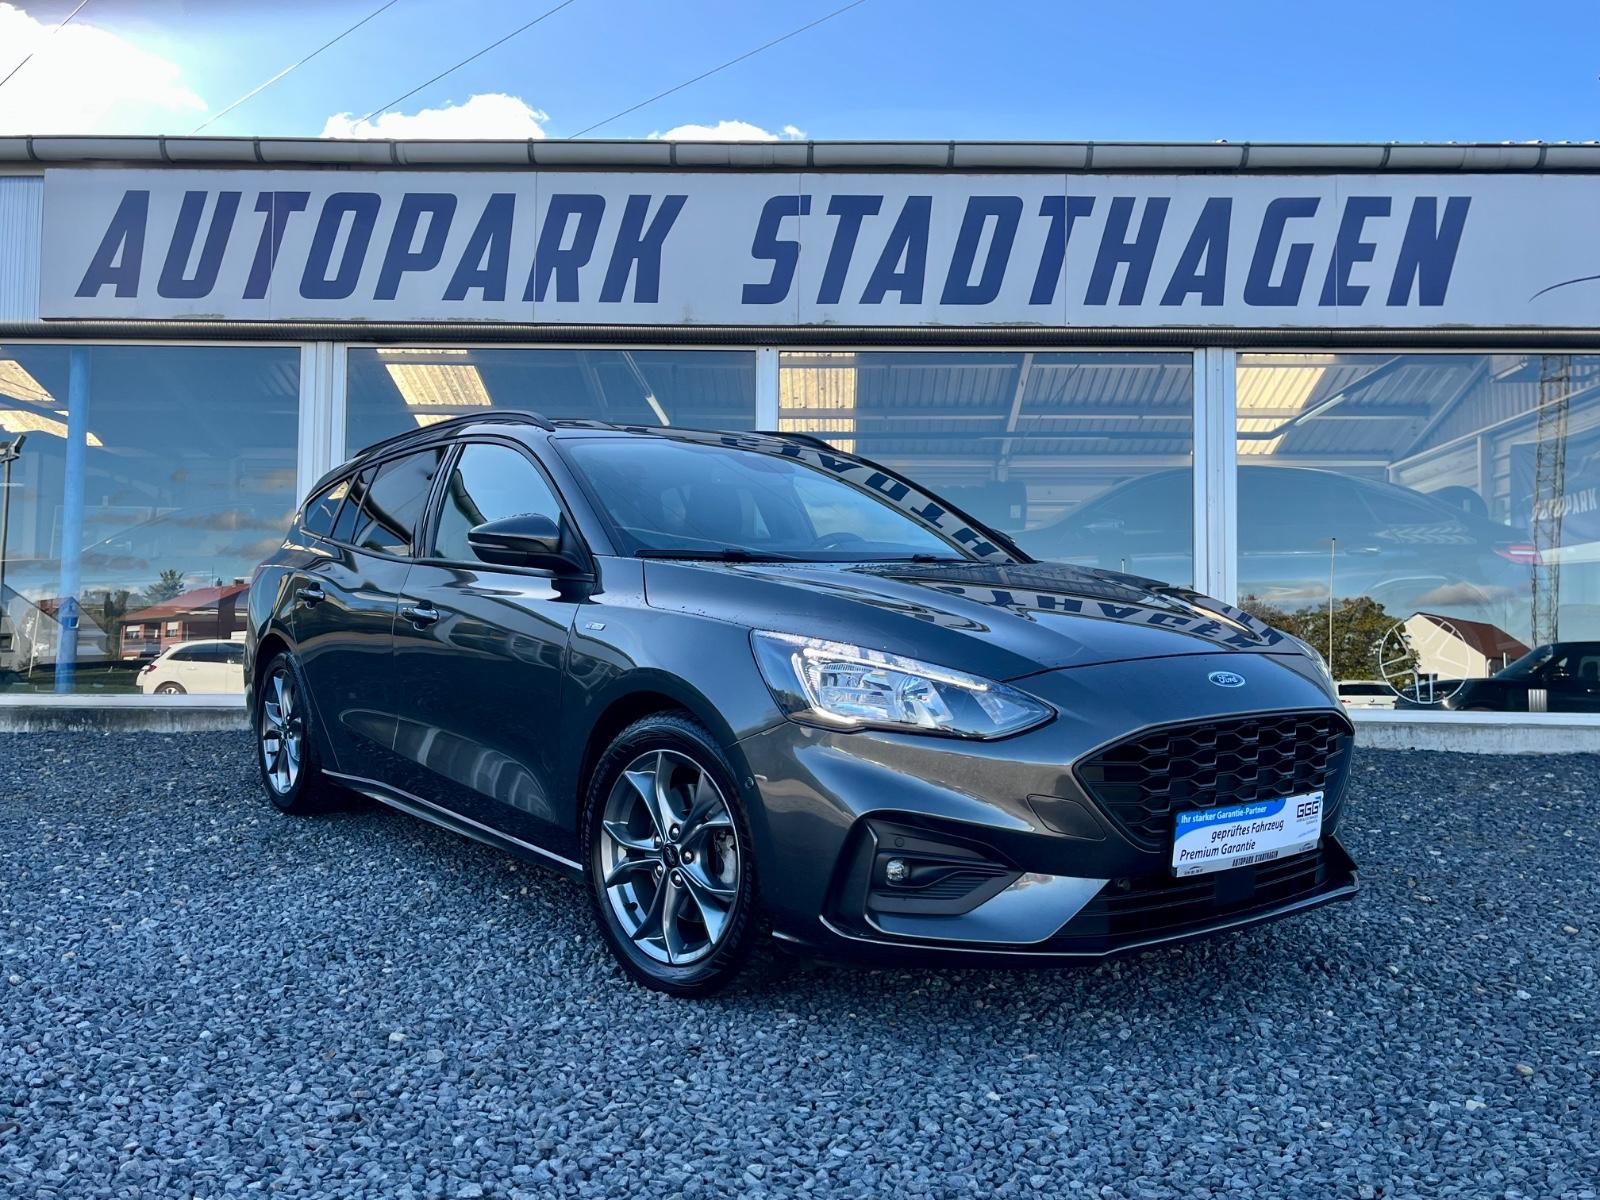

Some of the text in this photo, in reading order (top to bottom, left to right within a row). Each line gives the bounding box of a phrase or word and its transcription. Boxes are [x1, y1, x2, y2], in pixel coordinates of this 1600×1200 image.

[74, 189, 1473, 308] AUTOPARK STADTHAGEN
[1180, 805, 1268, 824] Ihr starker Garantie-Partner
[1296, 801, 1319, 819] GGG
[1211, 824, 1250, 843] geprüftes
[1251, 819, 1285, 835] Fahrzeug
[1179, 839, 1256, 861] Premium Garantie
